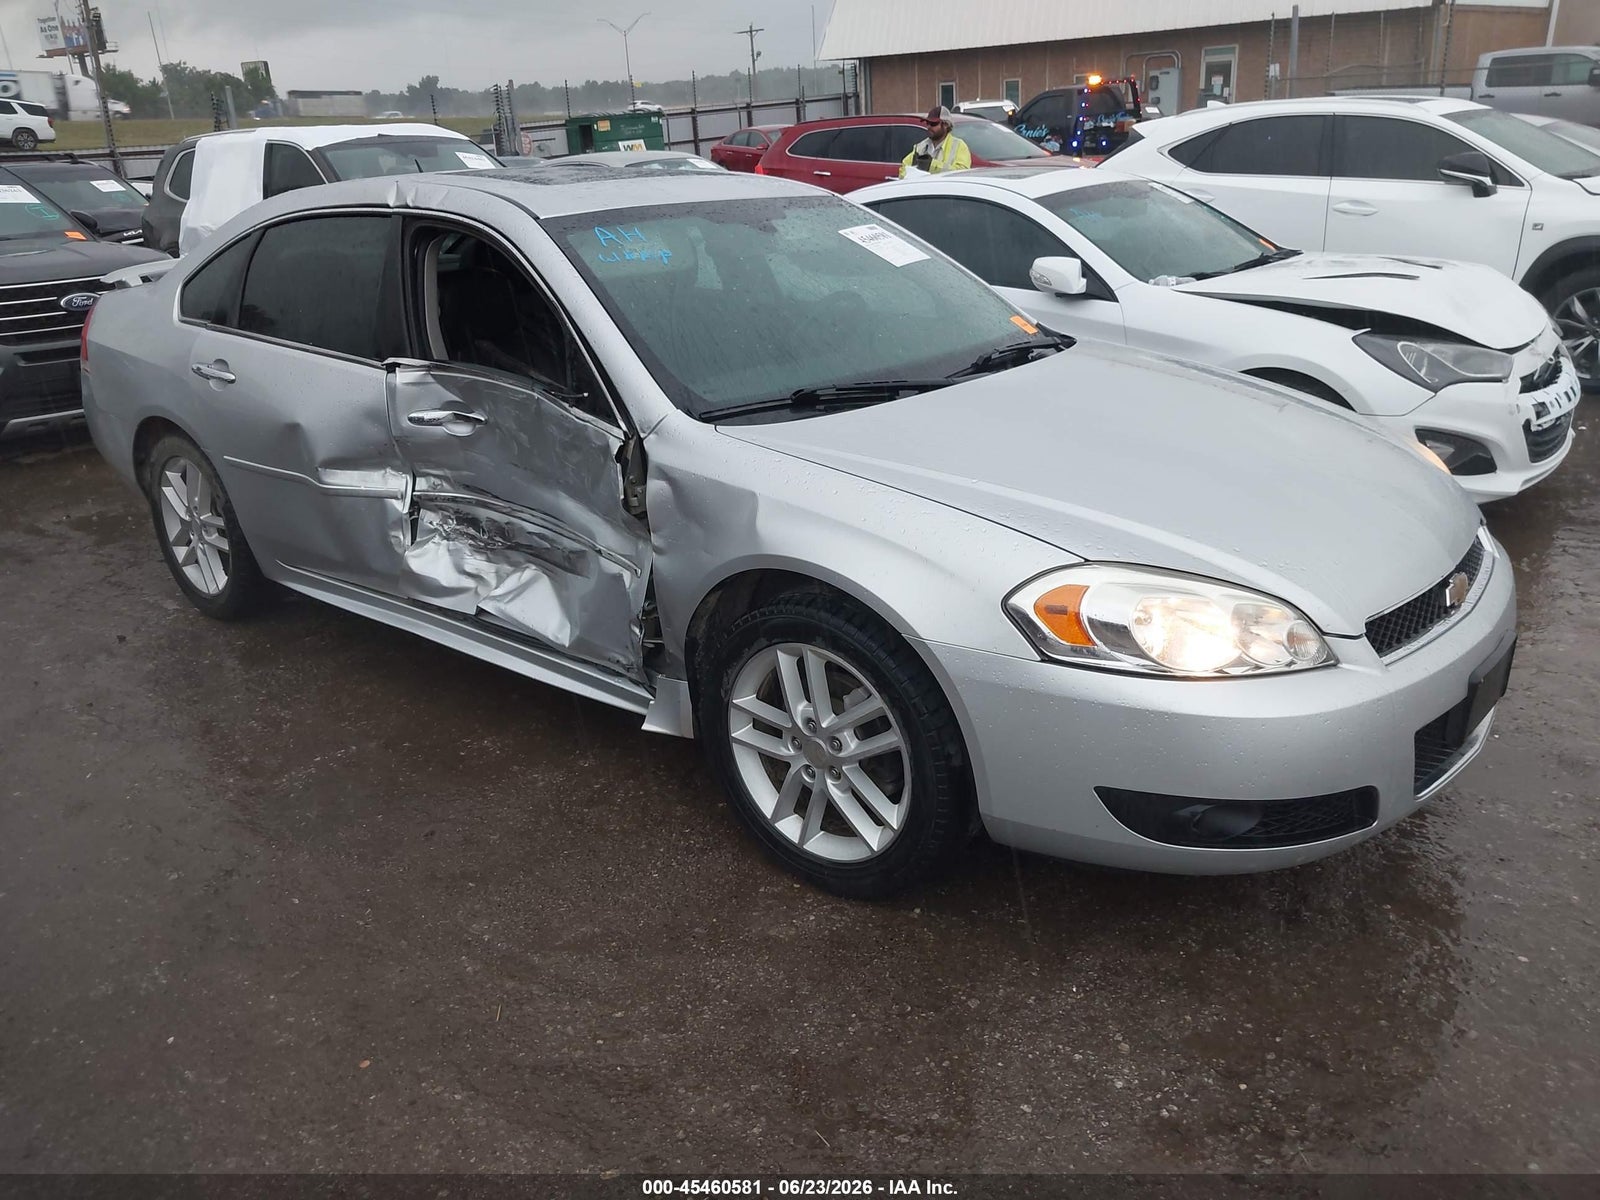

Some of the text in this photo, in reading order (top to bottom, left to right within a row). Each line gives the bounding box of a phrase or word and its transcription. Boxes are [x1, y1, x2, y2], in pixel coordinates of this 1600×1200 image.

[623, 143, 643, 151] WM
[594, 226, 647, 247] AH
[71, 296, 94, 307] Ford
